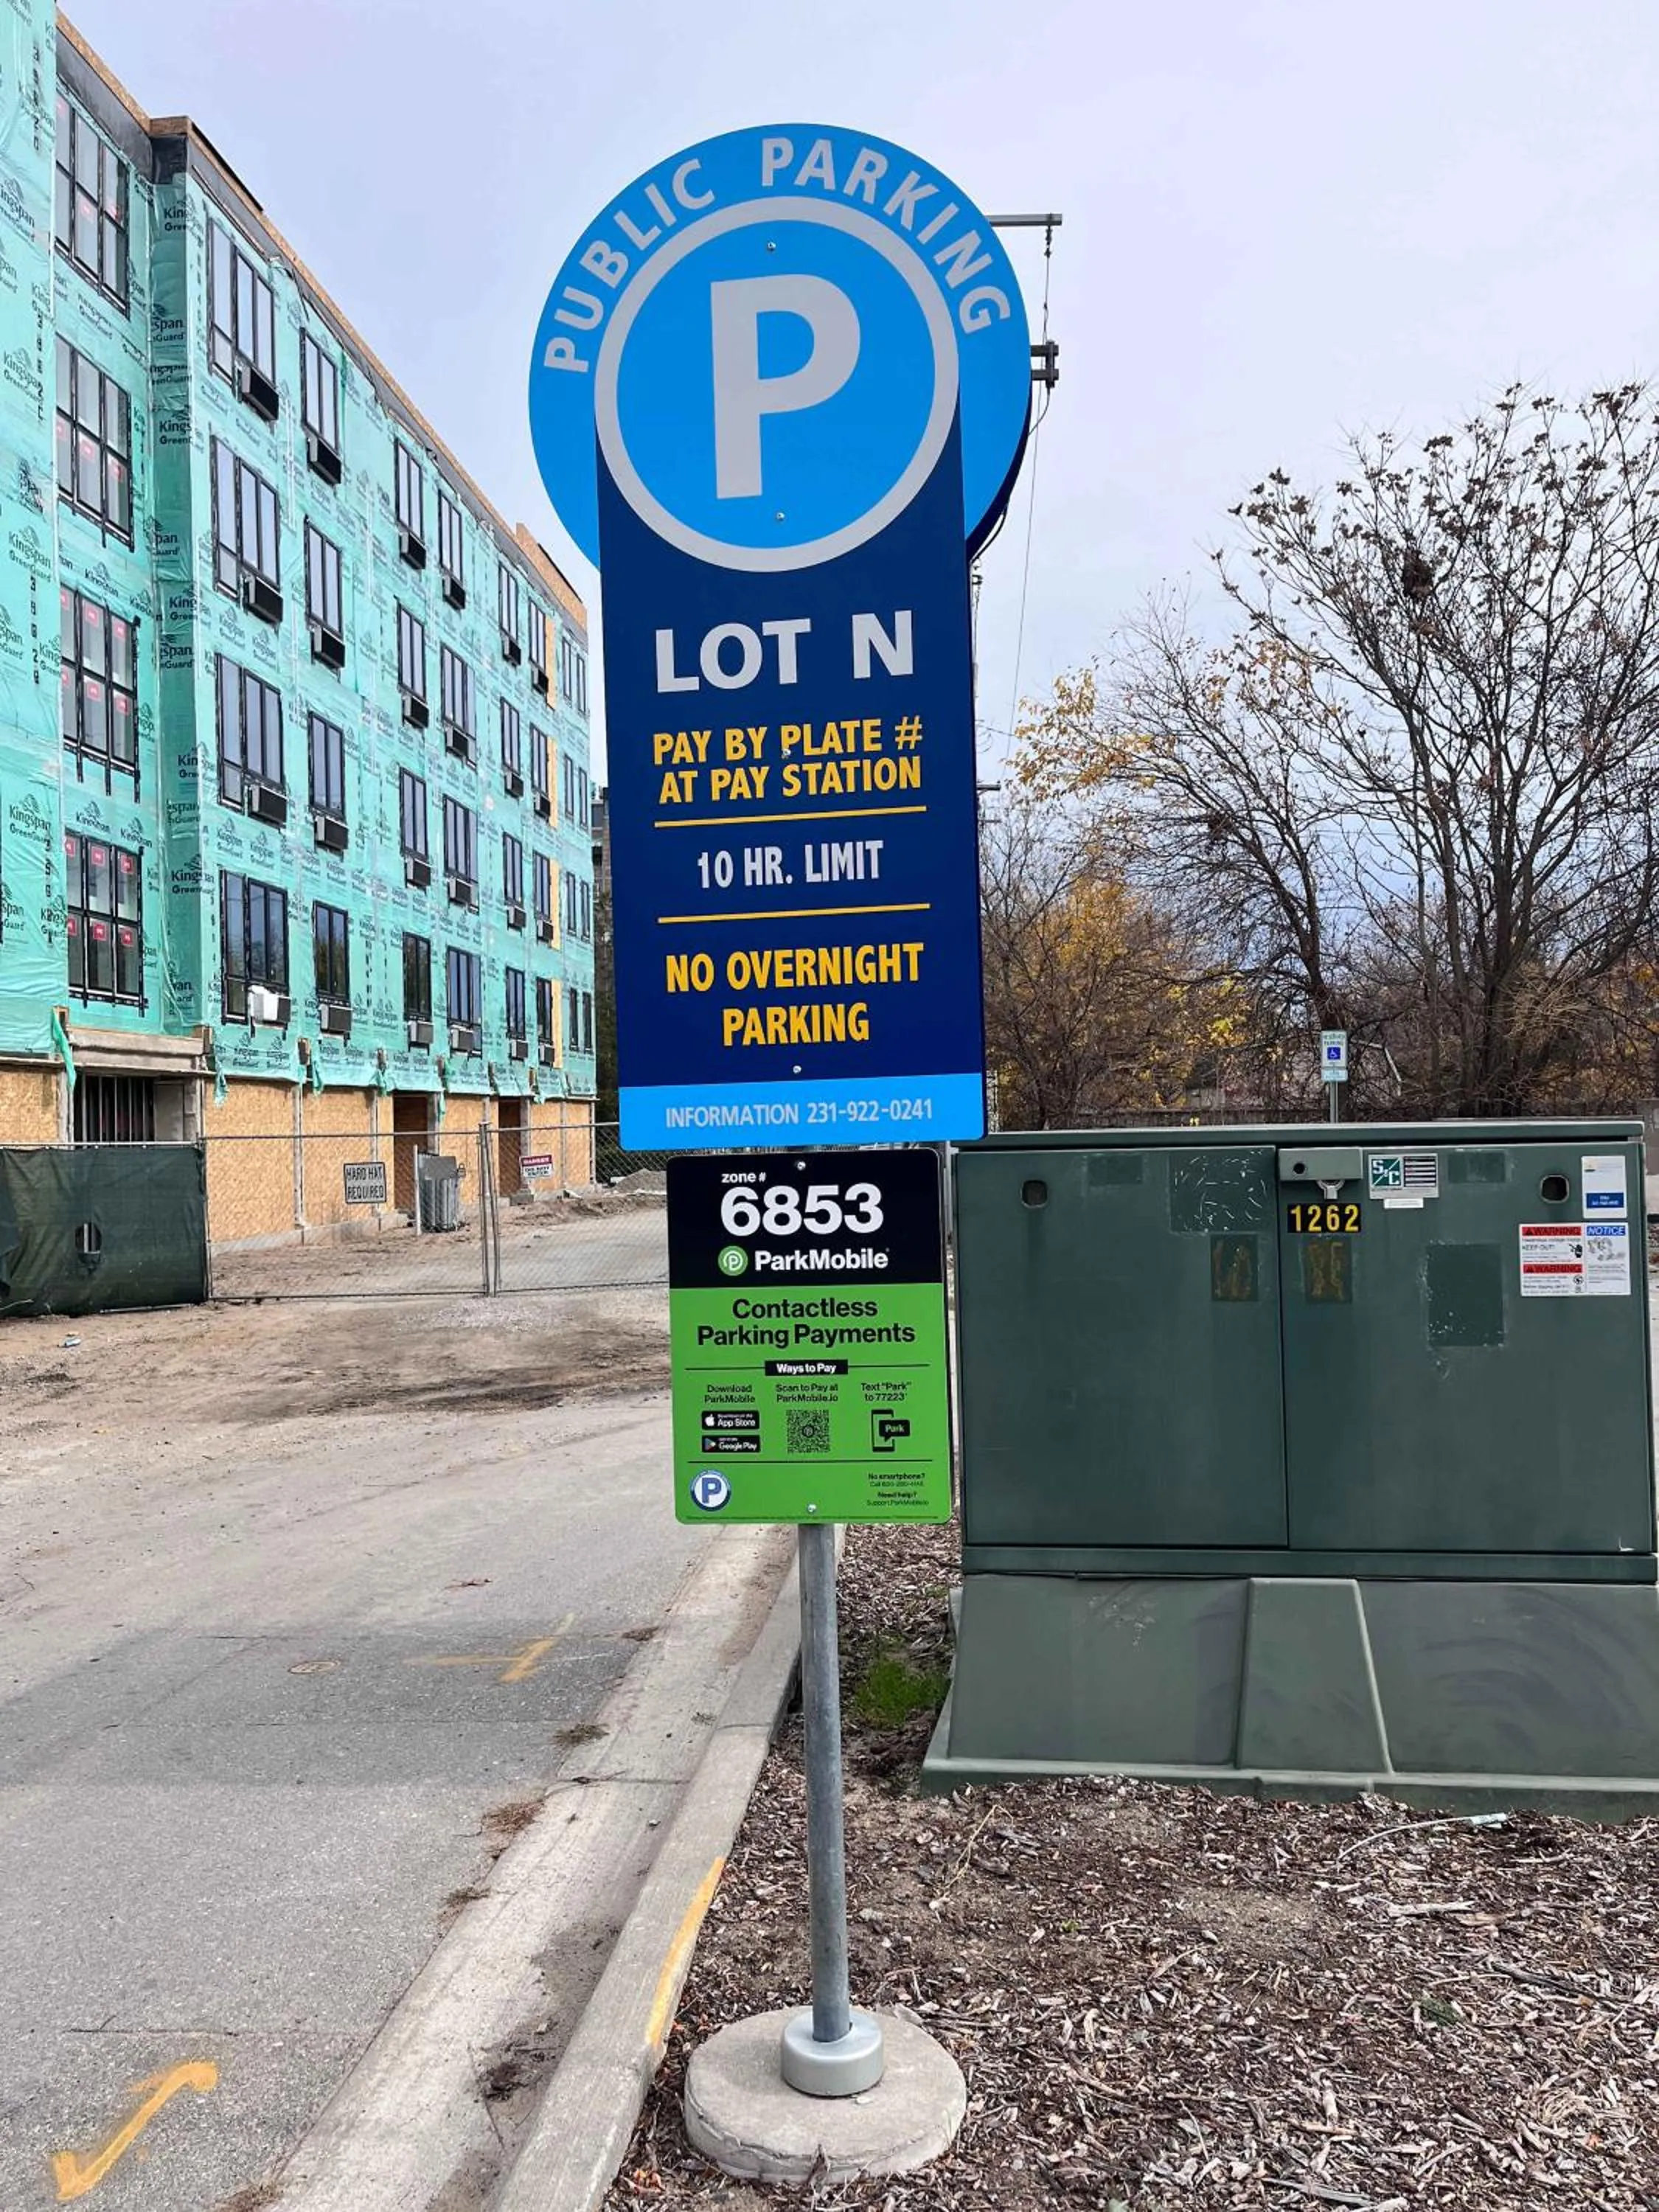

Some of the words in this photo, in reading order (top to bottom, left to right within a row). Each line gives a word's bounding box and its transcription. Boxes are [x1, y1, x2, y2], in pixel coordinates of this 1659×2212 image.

[543, 159, 714, 372] PUBLIC
[761, 137, 1011, 334] PARKING
[711, 274, 860, 499] P
[655, 618, 811, 692] LOT
[852, 611, 914, 679] N
[653, 731, 712, 765] PAY
[725, 727, 767, 761] BY
[781, 719, 882, 758] PLATE
[894, 715, 923, 751] #
[659, 771, 698, 804] AT
[711, 766, 769, 801] PAY
[782, 756, 921, 798] STATION
[698, 850, 734, 888] 10
[744, 846, 793, 886] HR.
[805, 840, 884, 883] LIMIT
[666, 953, 714, 993] NO
[727, 942, 925, 990] OVERNIGHT
[723, 1003, 870, 1046] PARKING
[666, 1103, 799, 1128] INFORMATION
[807, 1099, 933, 1124] 231-922-0241
[346, 1167, 366, 1180] HARD
[368, 1166, 383, 1180] HAT
[721, 1173, 757, 1184] zone
[759, 1172, 767, 1183] #
[347, 1185, 384, 1200] REQUIRED
[720, 1183, 884, 1237] 6853
[1290, 1204, 1359, 1232] 1262
[1587, 1226, 1626, 1236] NOTICE
[754, 1248, 889, 1272] ParkMobile
[732, 1298, 878, 1320] Contactless
[698, 1325, 790, 1349] Parking
[794, 1323, 916, 1348] Payments
[776, 1363, 804, 1375] Ways
[805, 1363, 816, 1373] to
[816, 1363, 837, 1374] Pay
[706, 1384, 753, 1393] Download
[776, 1384, 799, 1392] Scan
[800, 1384, 810, 1392] to
[811, 1383, 828, 1393] Pay
[830, 1383, 838, 1391] at
[860, 1382, 880, 1391] Text
[864, 1393, 874, 1402] to
[704, 1394, 756, 1404] ParkMobile
[717, 1419, 734, 1428] App
[734, 1418, 756, 1427] Store
[885, 1424, 905, 1433] Park
[718, 1441, 742, 1451] Google
[742, 1441, 757, 1451] Play
[701, 1477, 722, 1503] P
